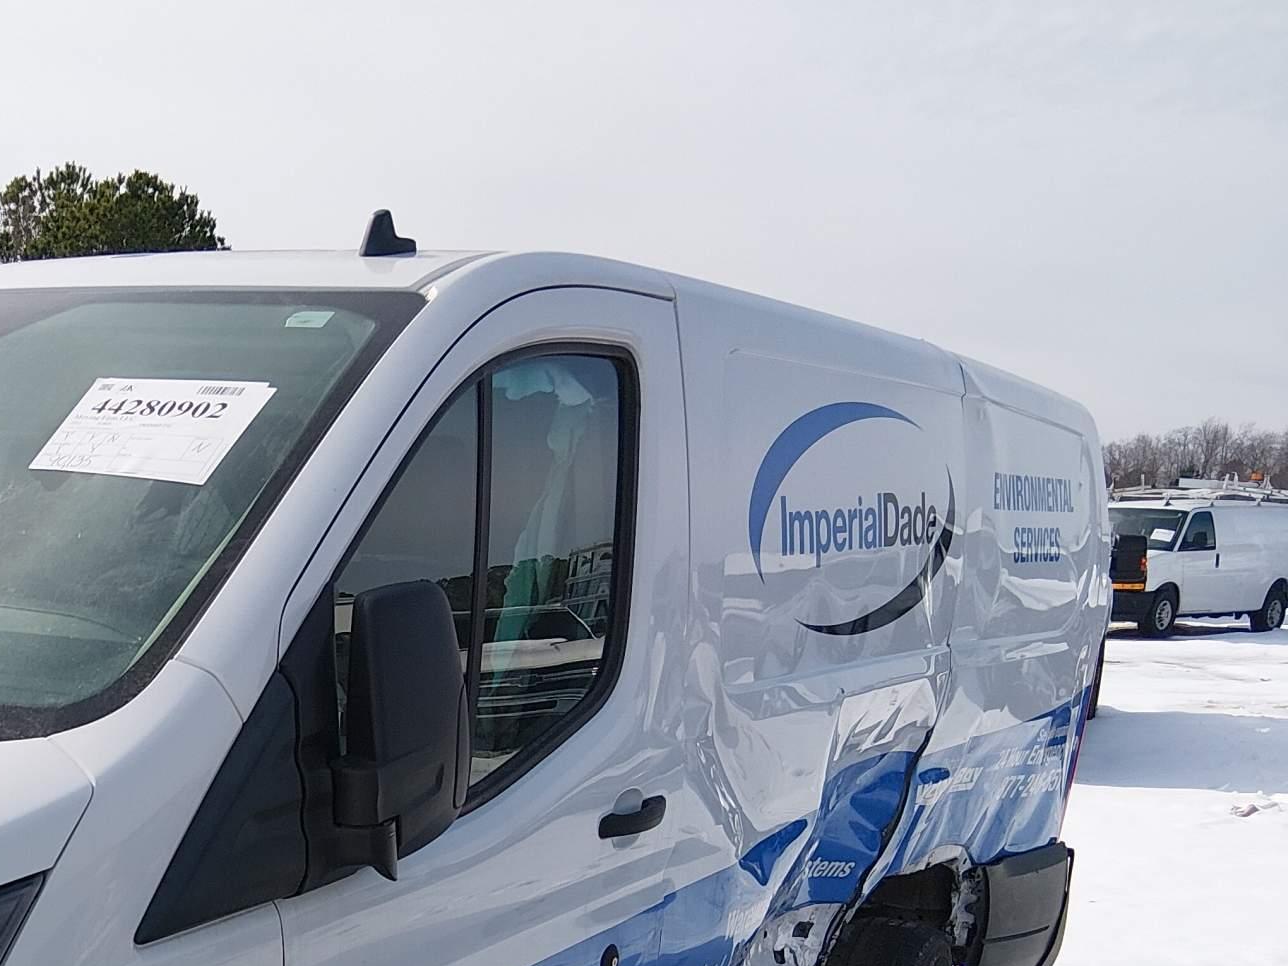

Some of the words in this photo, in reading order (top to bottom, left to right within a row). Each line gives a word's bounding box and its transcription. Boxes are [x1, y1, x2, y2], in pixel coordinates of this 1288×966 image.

[91, 398, 228, 419] 44280902
[993, 472, 1074, 512] ENVIRONMENTAL
[780, 492, 937, 568] ImperialDade
[1013, 527, 1061, 563] SERVICES
